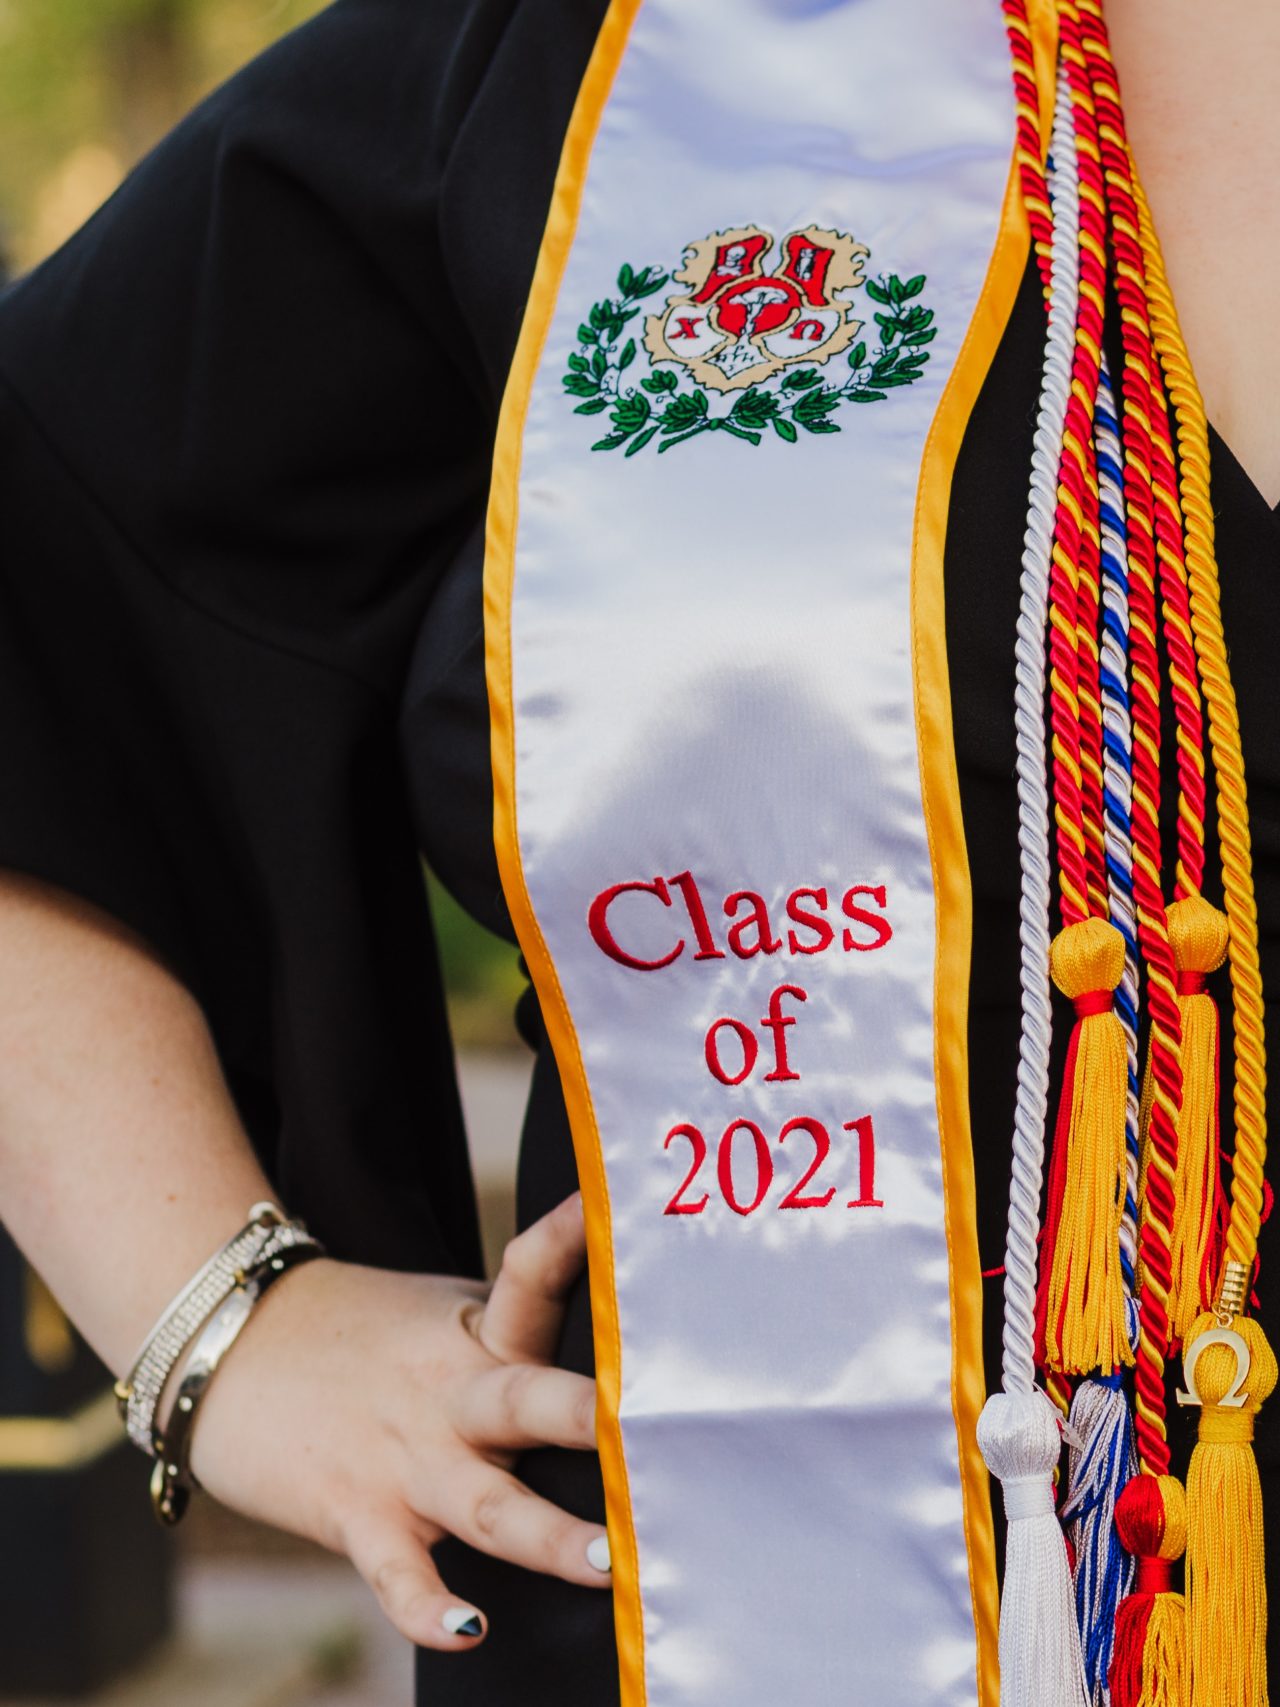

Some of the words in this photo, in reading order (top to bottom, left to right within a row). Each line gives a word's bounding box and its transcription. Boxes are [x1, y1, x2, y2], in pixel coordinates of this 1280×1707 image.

[588, 870, 893, 972] Class
[704, 984, 808, 1086] of
[663, 1115, 884, 1217] 2021
[1175, 1328, 1250, 1408] Ω
